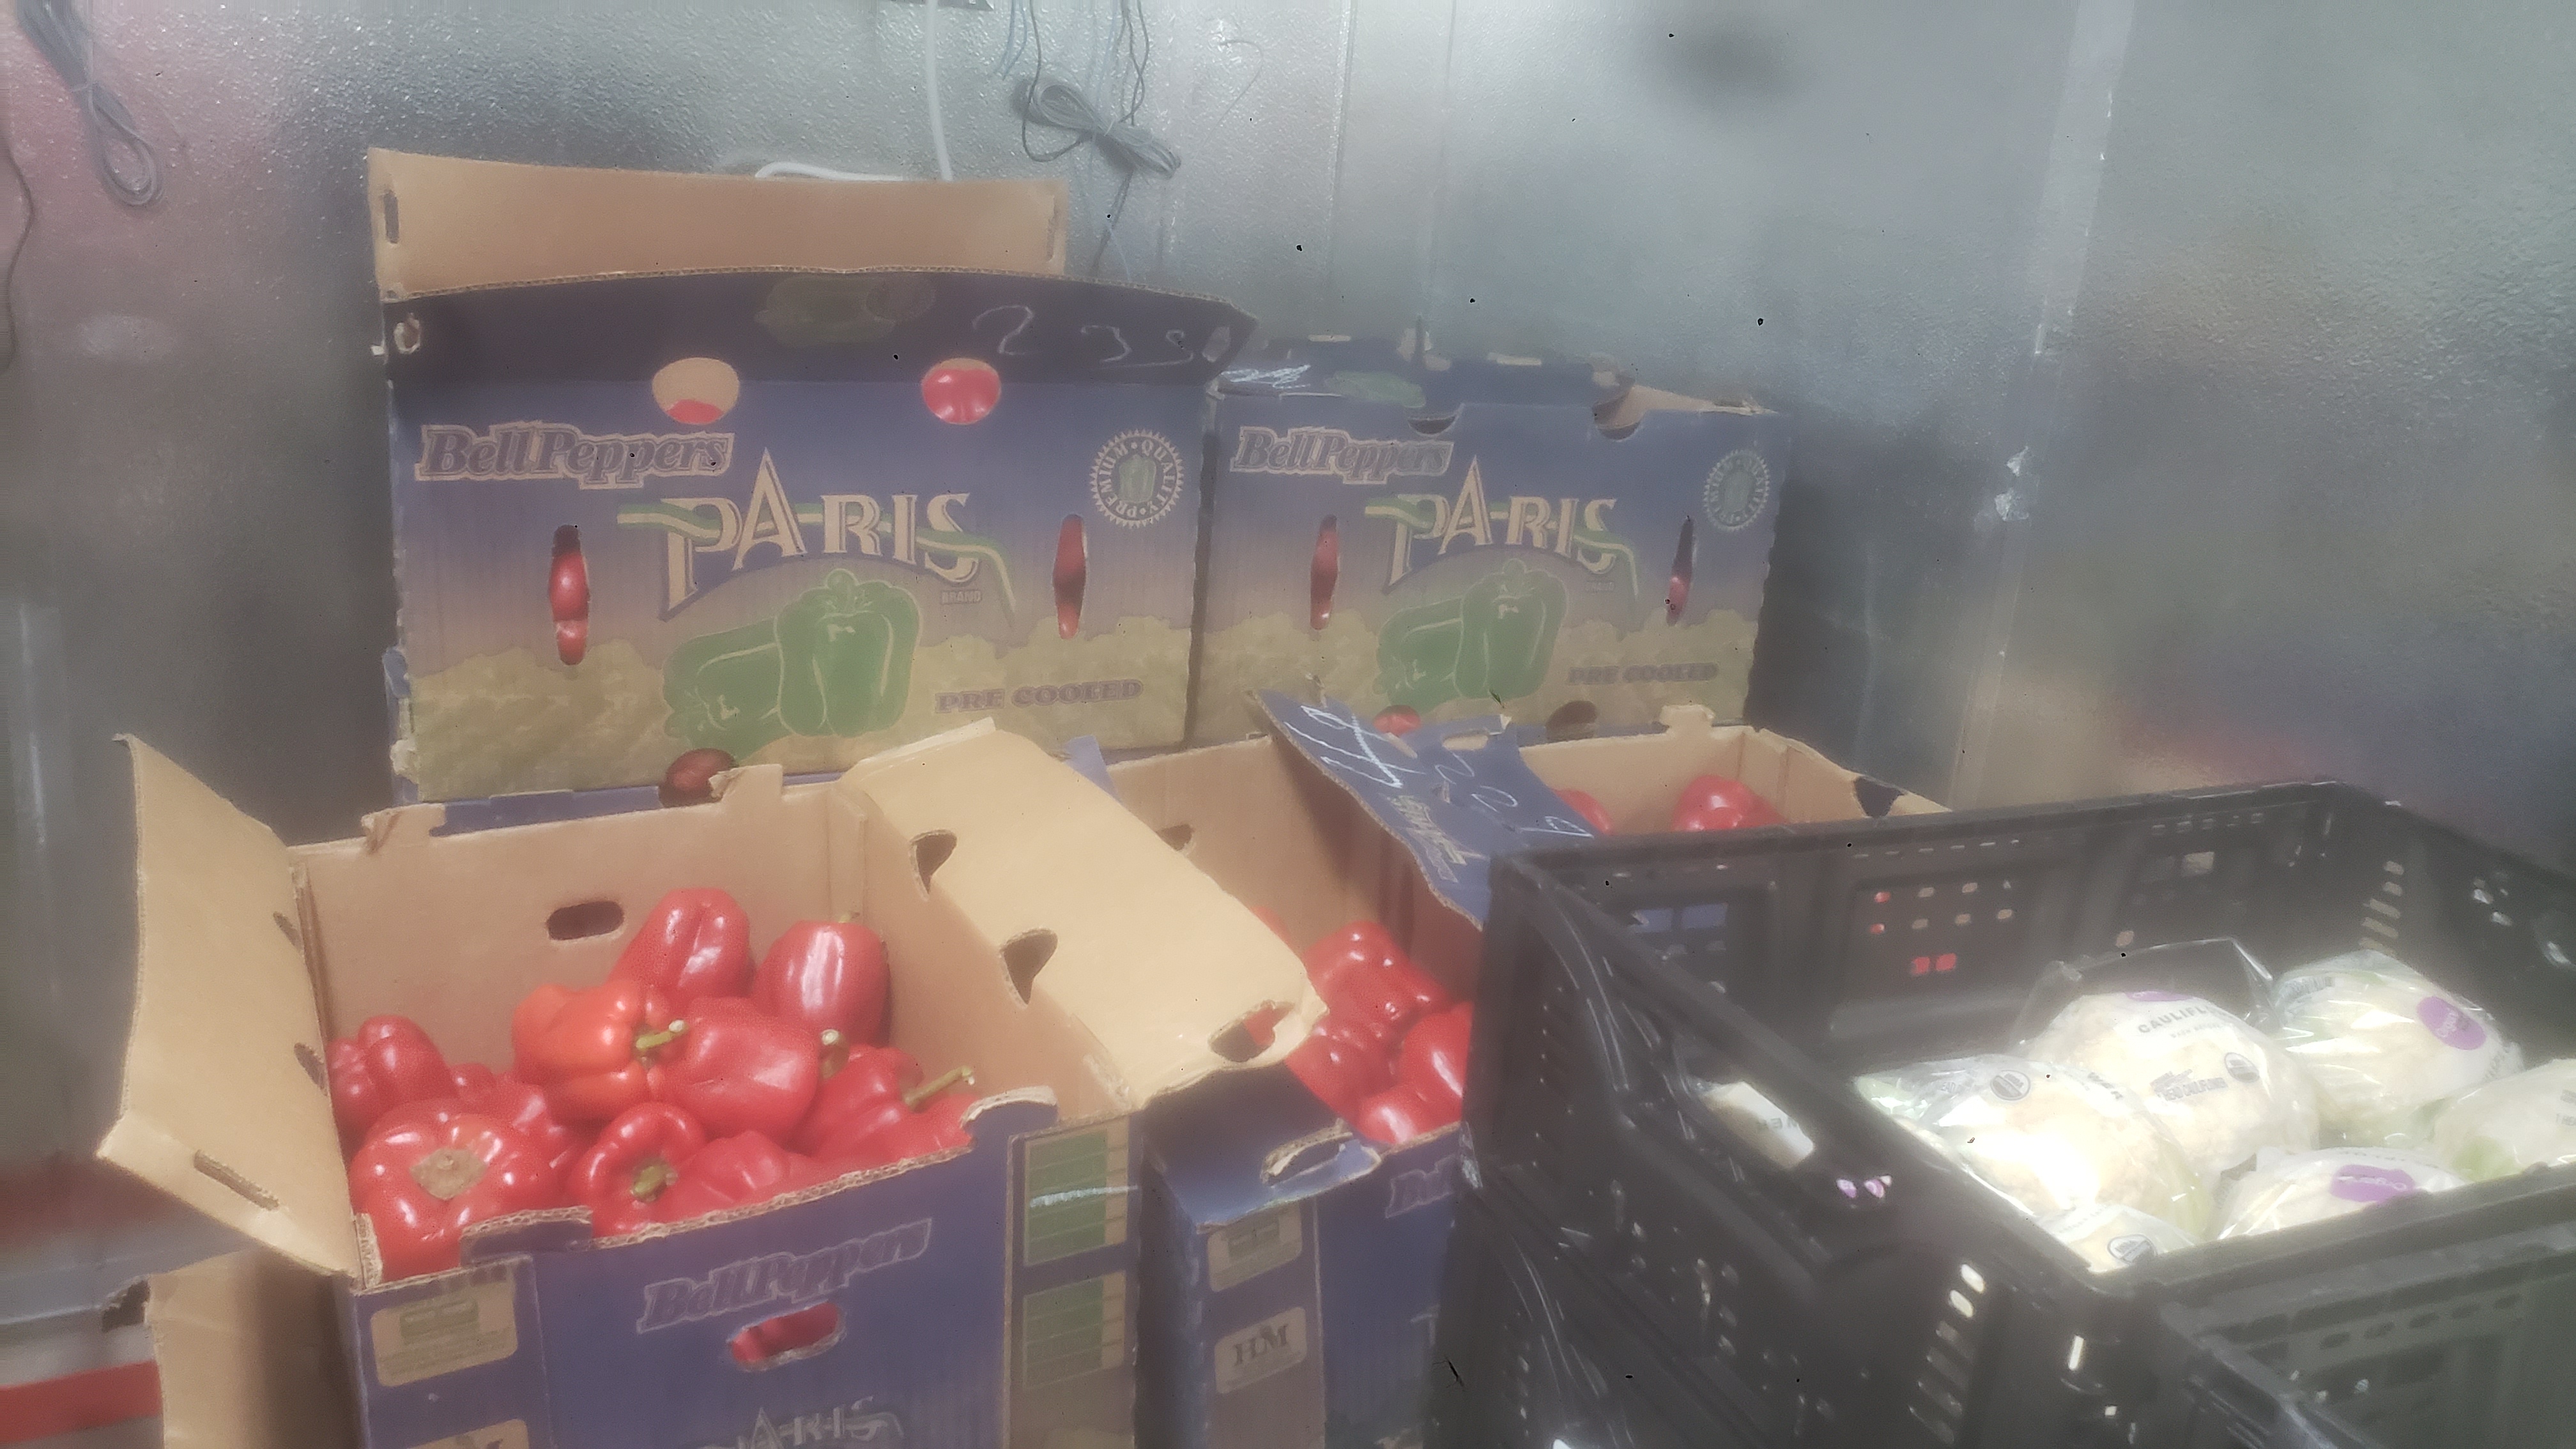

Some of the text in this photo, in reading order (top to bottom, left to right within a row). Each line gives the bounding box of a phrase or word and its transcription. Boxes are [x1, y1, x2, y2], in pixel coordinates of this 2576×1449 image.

[658, 448, 979, 621] PARIS
[1385, 456, 1617, 593] PARIS
[935, 678, 1144, 714] PRE COOLED
[2138, 1005, 2236, 1034] CAULIFL
[694, 1395, 884, 1449] ARIS
